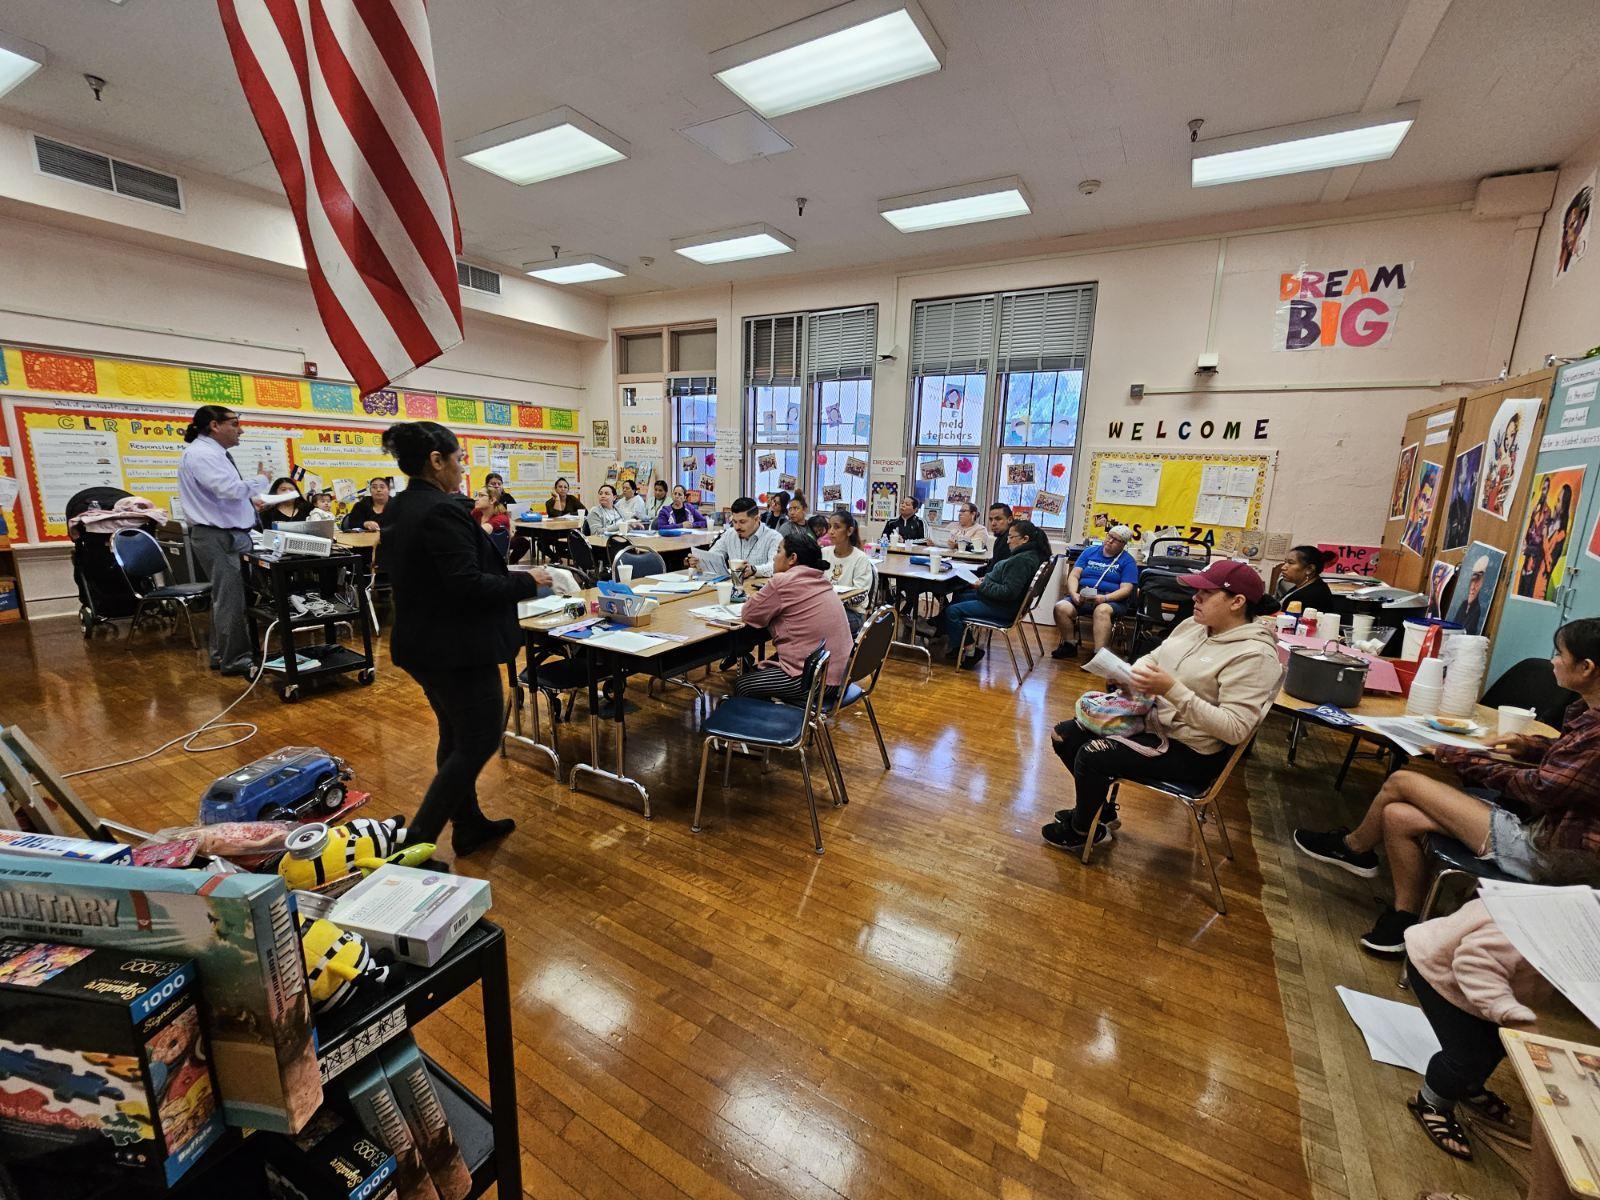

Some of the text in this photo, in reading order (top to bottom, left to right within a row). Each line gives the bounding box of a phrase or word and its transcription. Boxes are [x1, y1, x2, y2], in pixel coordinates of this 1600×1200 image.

[1280, 264, 1406, 301] DREAM
[1286, 297, 1390, 350] BIG
[58, 416, 118, 432] CLR
[631, 425, 647, 433] CLR
[927, 430, 972, 440] teachers
[940, 420, 964, 428] meld
[1108, 419, 1269, 441] WELCOME
[319, 433, 364, 445] MELD
[623, 436, 657, 445] LIBRARY
[1338, 546, 1366, 559] The
[269, 894, 303, 1002] MILITARY
[142, 974, 185, 1013] 1000
[142, 993, 190, 1034] Signature
[407, 1067, 446, 1135] MILITARY
[18, 1107, 61, 1125] Perfect
[370, 1088, 412, 1152] MILITARY
[357, 1166, 389, 1200] 1000
